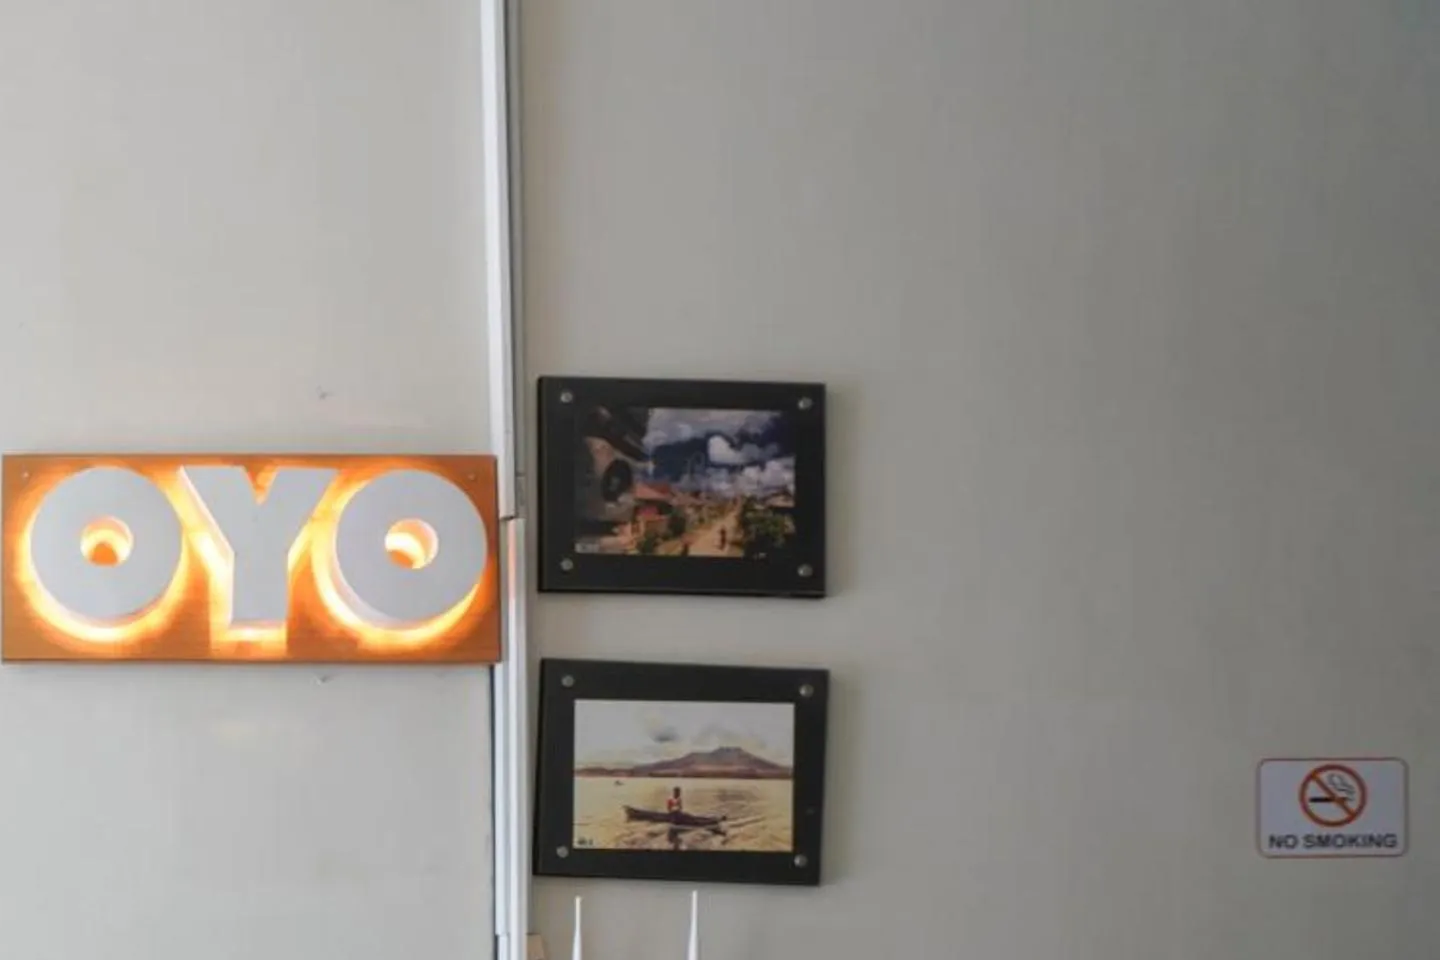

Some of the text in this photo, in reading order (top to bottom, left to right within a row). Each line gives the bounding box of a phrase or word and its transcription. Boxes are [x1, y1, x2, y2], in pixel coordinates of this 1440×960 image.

[29, 465, 488, 630] OYO
[1269, 833, 1398, 849] NO SMOKING
